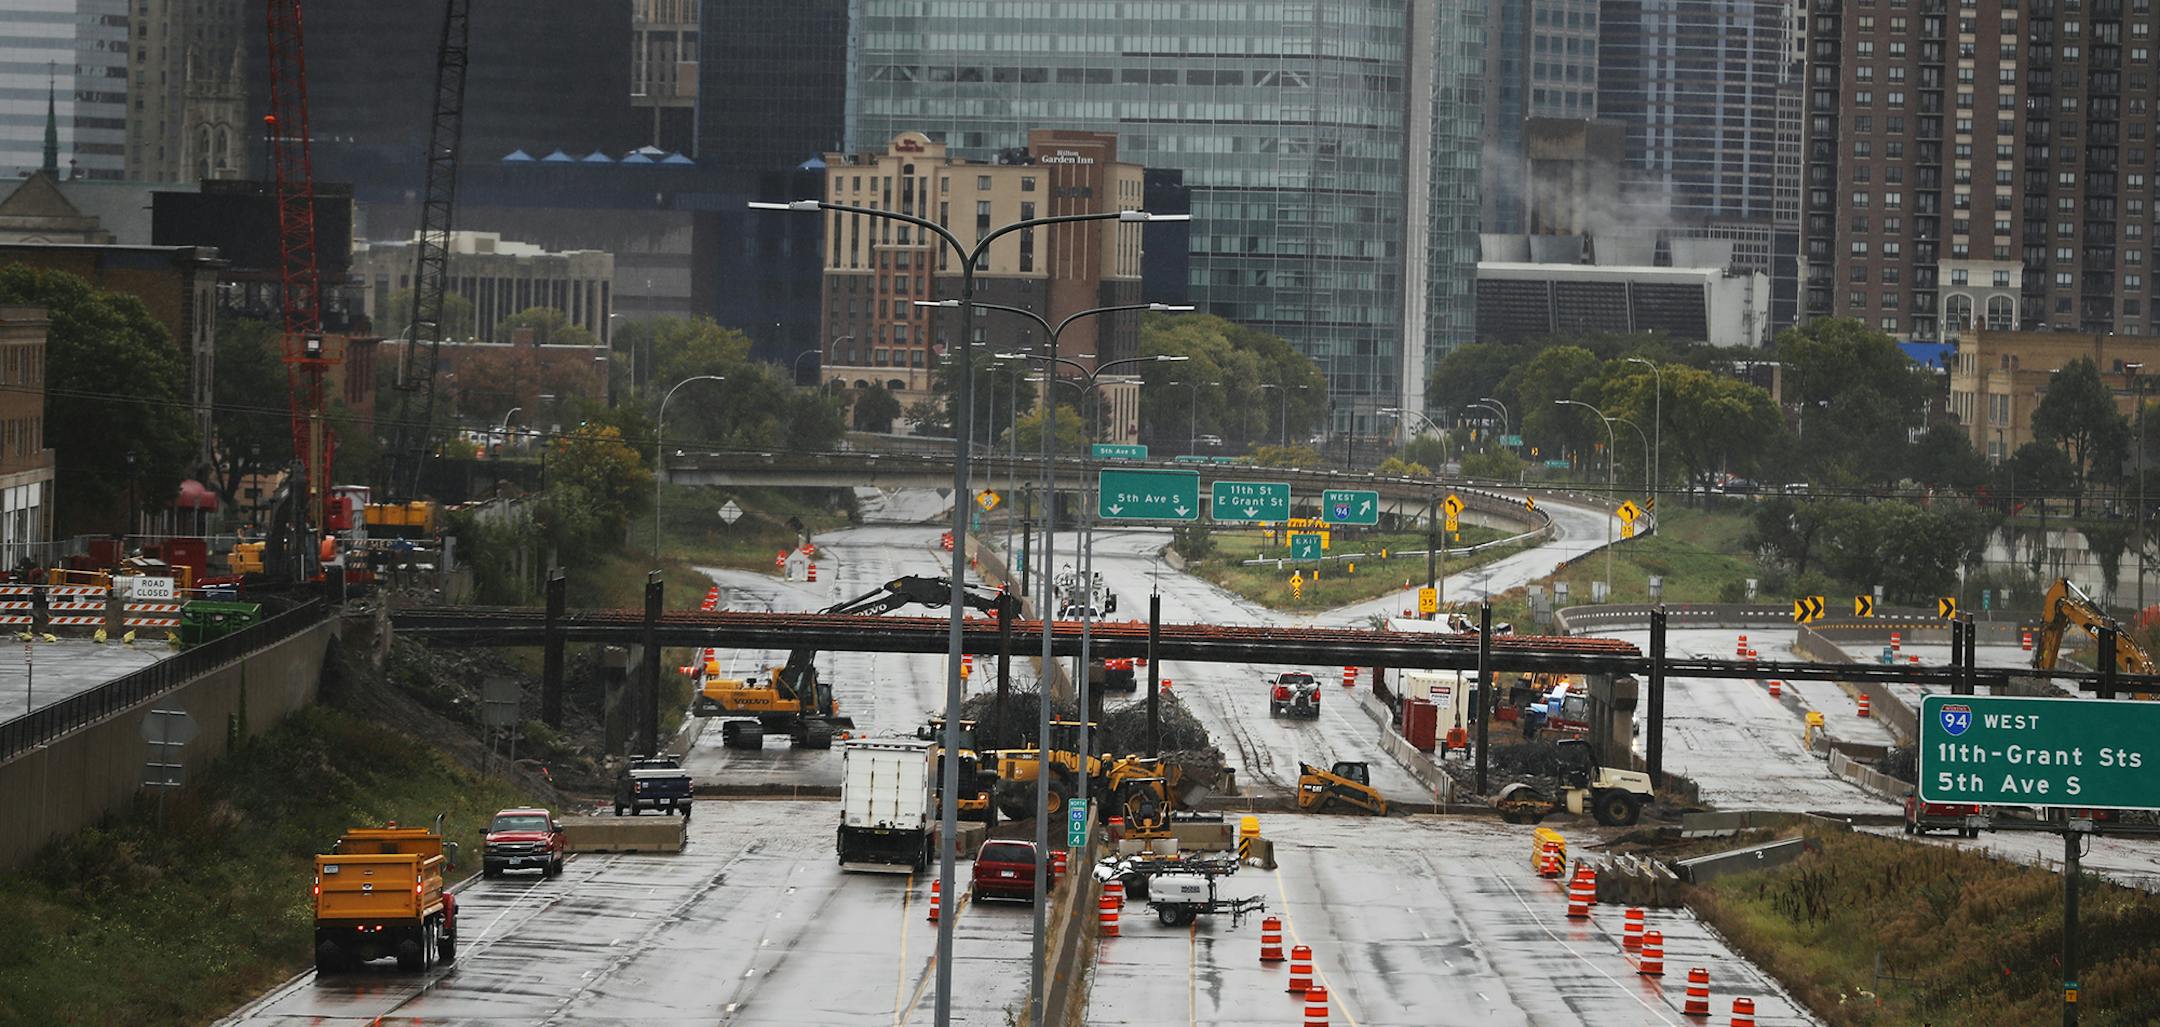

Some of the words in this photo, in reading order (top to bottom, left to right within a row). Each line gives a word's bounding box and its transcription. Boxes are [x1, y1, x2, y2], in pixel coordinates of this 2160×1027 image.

[1041, 155, 1076, 164] Garden
[1078, 156, 1094, 164] Inn
[1100, 447, 1113, 455] 5th
[1115, 447, 1129, 455] Ave
[1230, 485, 1254, 495] 11th
[1260, 486, 1272, 496] St
[1118, 493, 1139, 503] 5th
[1145, 494, 1167, 503] Ave
[1172, 494, 1180, 504] S
[1218, 496, 1226, 505] E
[1231, 496, 1265, 506] Grant
[1270, 497, 1283, 507] St
[1335, 506, 1348, 517] 94
[141, 580, 165, 588] ROAD
[136, 589, 169, 597] CLOSED
[1422, 598, 1434, 606] 35
[1945, 713, 1967, 728] 94
[1984, 714, 2040, 730] WEST
[1938, 743, 2083, 767] 11th-Grant
[2099, 747, 2142, 768] Sts
[1312, 785, 1323, 793] CAT
[1938, 772, 1984, 793] 5th
[2000, 774, 2050, 795] Ave
[2065, 776, 2082, 796] S
[1073, 821, 1081, 831] 0
